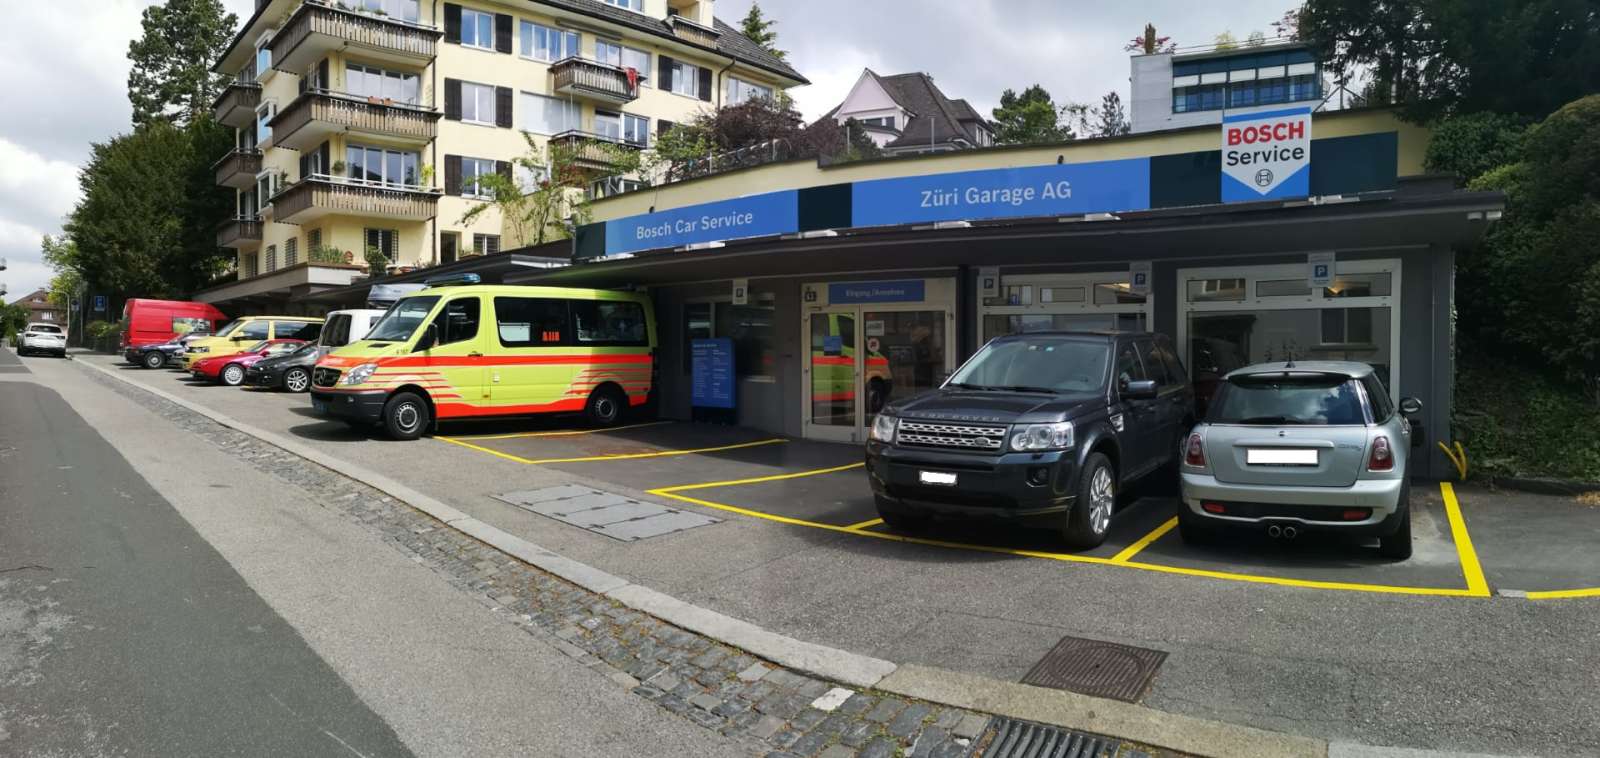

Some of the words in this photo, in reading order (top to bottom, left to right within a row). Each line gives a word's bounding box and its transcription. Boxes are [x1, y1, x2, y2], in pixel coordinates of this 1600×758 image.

[1228, 121, 1304, 146] BOSCH
[1227, 145, 1304, 166] Service
[920, 187, 958, 207] Züri
[965, 187, 1035, 206] Garage
[1041, 181, 1072, 200] AG
[636, 220, 671, 240] Bosch
[675, 218, 697, 234] Car
[701, 210, 753, 229] Service
[1318, 267, 1325, 276] P
[952, 414, 1000, 422] ROVER
